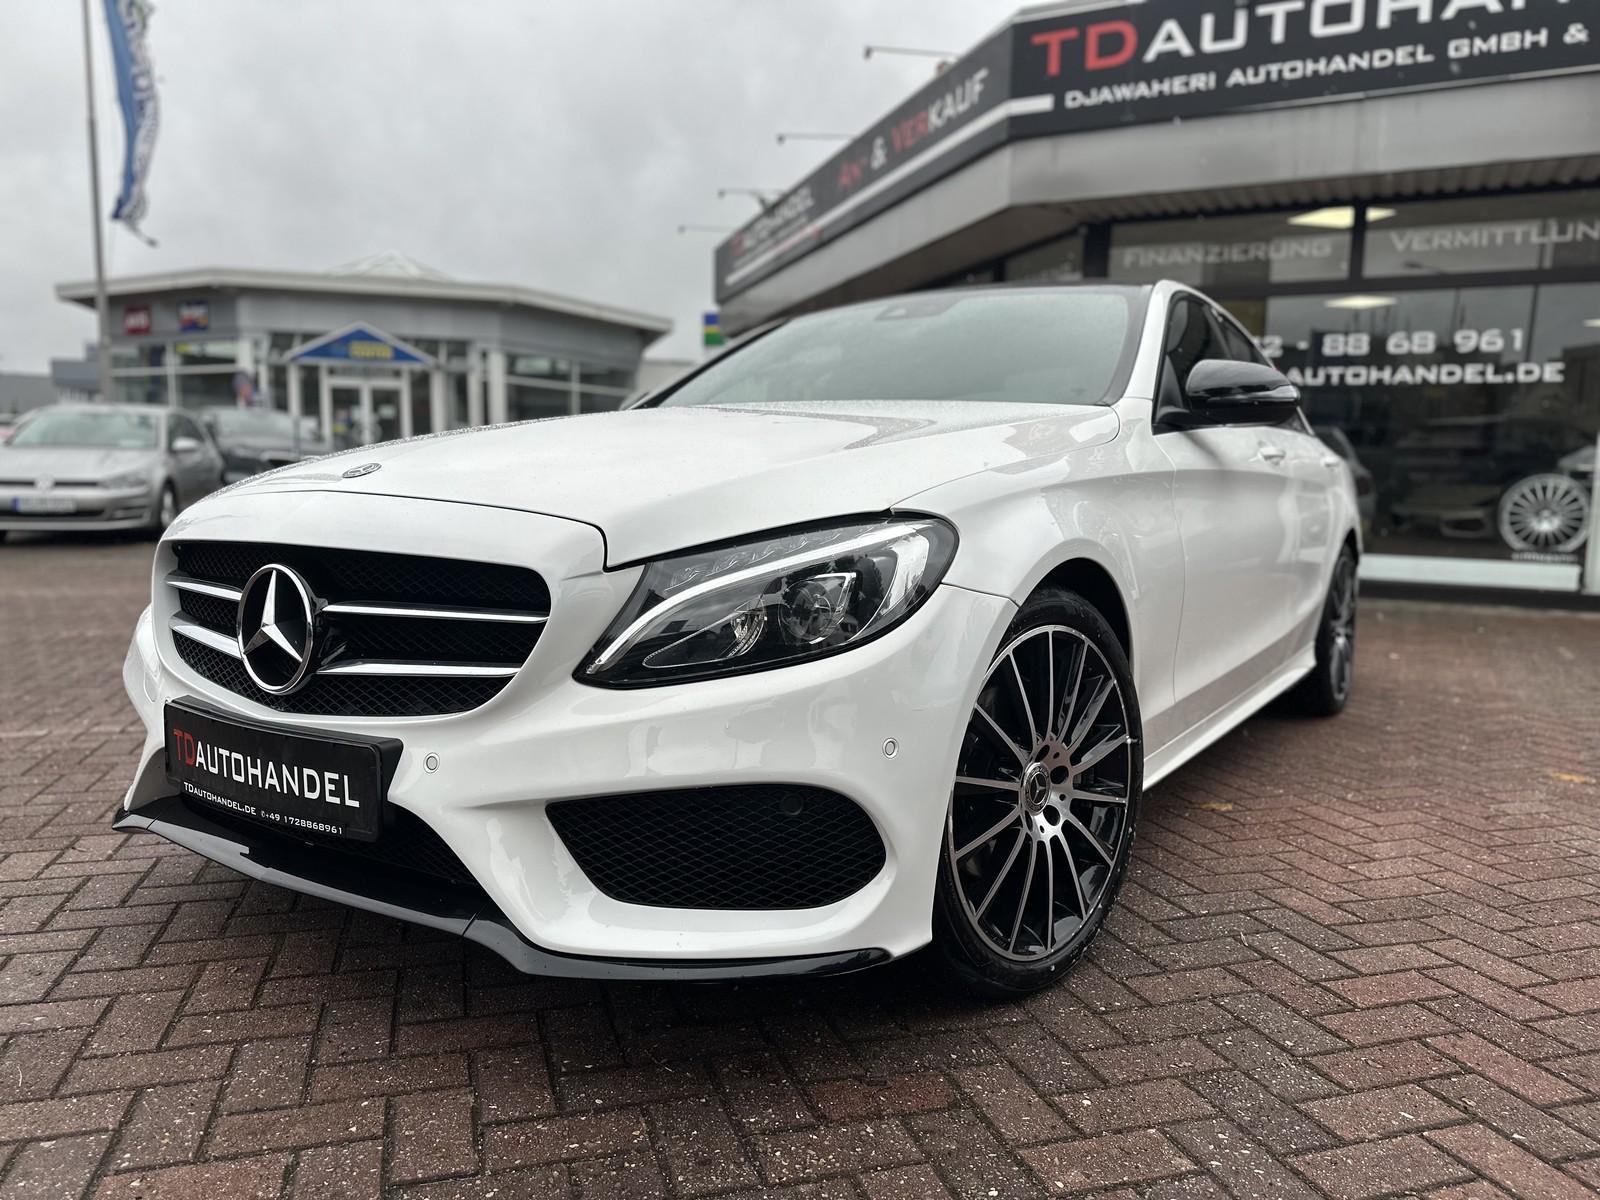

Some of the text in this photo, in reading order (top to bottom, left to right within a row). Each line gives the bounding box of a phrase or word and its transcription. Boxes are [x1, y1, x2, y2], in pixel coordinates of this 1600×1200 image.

[1031, 0, 1570, 77] TDAUTOH
[1064, 22, 1590, 109] DJAWAHERI AUTOHANDEL GMBH &
[1123, 239, 1332, 269] FINANZIERUNG
[1321, 333, 1370, 357] 88
[1386, 331, 1436, 355] 68
[1454, 328, 1524, 354] 961
[173, 728, 361, 808] TDAUTOHANDEL
[183, 781, 257, 816] TDAUTOHANDEL.DE
[284, 815, 343, 835] 1728868961
